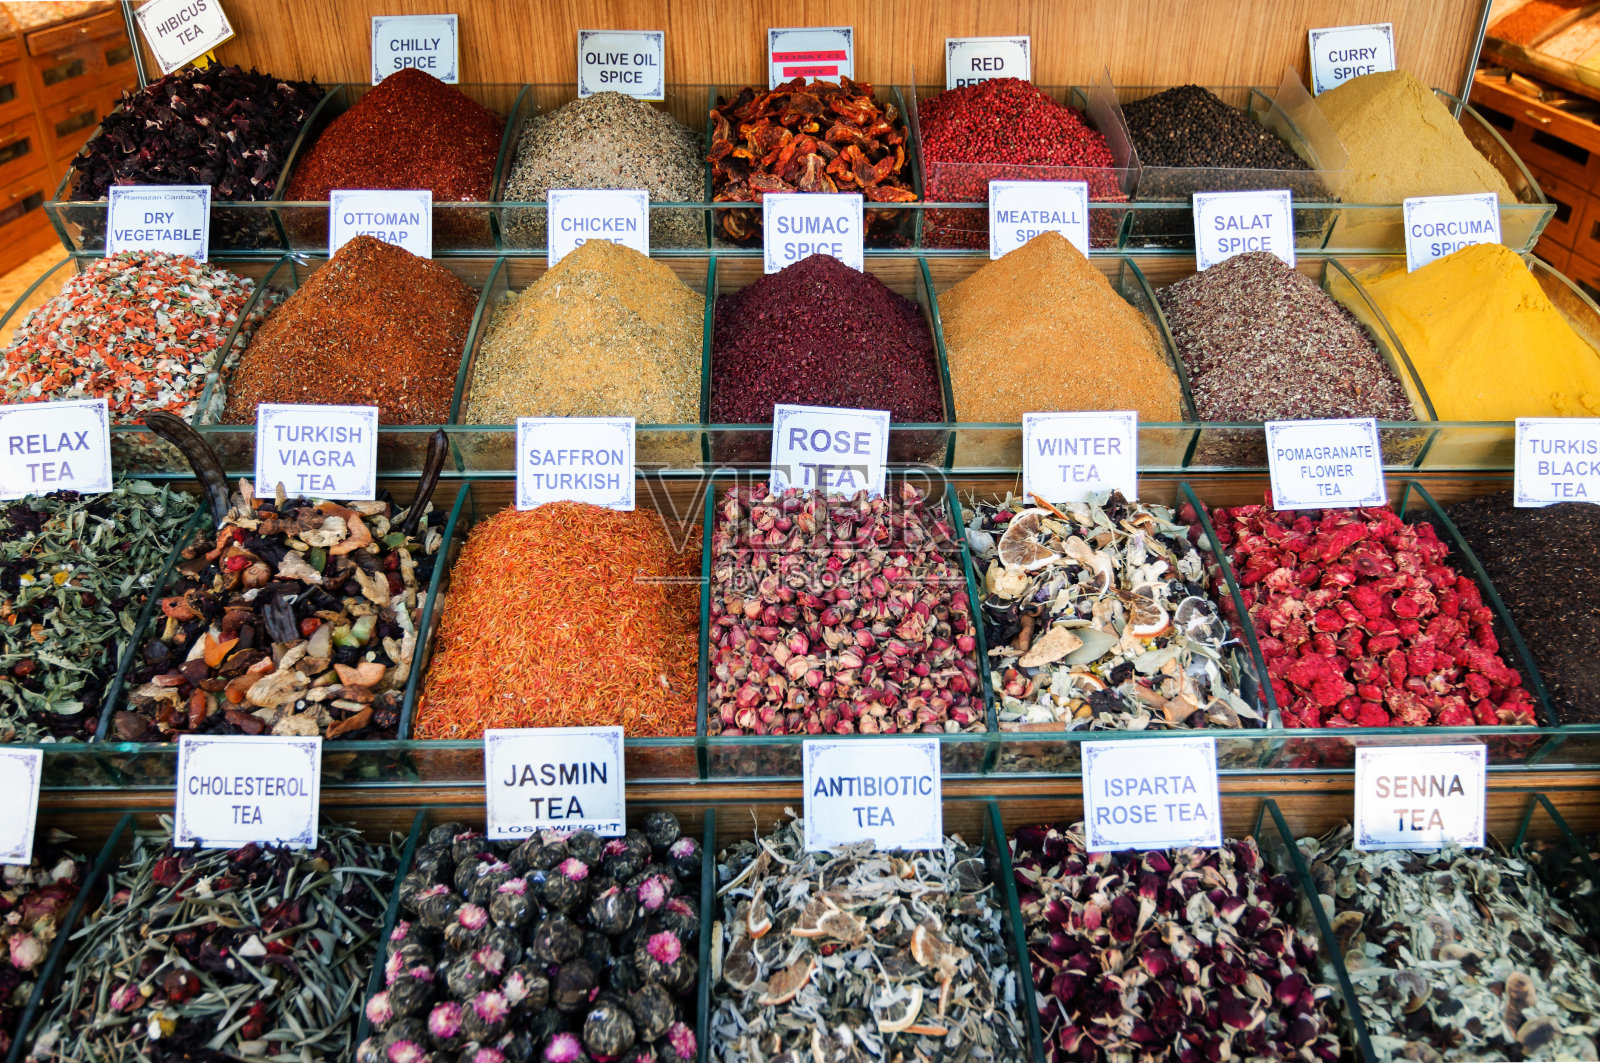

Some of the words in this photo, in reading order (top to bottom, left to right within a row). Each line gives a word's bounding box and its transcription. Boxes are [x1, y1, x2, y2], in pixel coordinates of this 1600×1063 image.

[156, 0, 207, 38] HIBICUS
[176, 24, 204, 46] TEA
[390, 38, 441, 52] CHILLY
[393, 56, 437, 69] SPICE
[585, 52, 629, 66] OLIVE
[634, 53, 658, 66] OIL
[971, 57, 1005, 71] RED
[1328, 47, 1377, 63] CURRY
[599, 70, 643, 84] SPICE
[144, 212, 174, 224] DRY
[343, 212, 420, 225] OTTOMAN
[561, 217, 637, 231] CHICKEN
[777, 216, 849, 234] SUMAC
[997, 210, 1080, 224] MEATBALL
[1214, 214, 1272, 231] SALAT
[114, 229, 202, 241] VEGETABLE
[1412, 219, 1494, 238] CORCUMA
[784, 242, 843, 260] SPICE
[1218, 236, 1271, 253] SPICE
[9, 431, 91, 455] RELAX
[274, 425, 362, 443] TURKISH
[789, 428, 871, 455] ROSE
[1037, 437, 1122, 457] WINTER
[1277, 445, 1373, 461] POMAGRANATE
[1529, 439, 1600, 455] TURKIS
[278, 449, 356, 468] VIAGRA
[529, 449, 624, 466] SAFFRON
[26, 461, 75, 483] TEA
[798, 462, 857, 488] TEA
[1058, 464, 1101, 483] TEA
[1300, 464, 1354, 479] FLOWER
[1538, 461, 1600, 476] BLACK
[297, 474, 336, 490] TEA
[533, 473, 620, 490] TURKISH
[1316, 483, 1342, 497] TEA
[1551, 482, 1588, 497] TEA
[503, 761, 608, 787] JASMIN
[188, 776, 309, 798] CHOLESTEROL
[813, 775, 933, 798] ANTIBIOTIC
[1104, 774, 1197, 797] ISPARTA
[1376, 774, 1464, 799] SENNA
[231, 805, 263, 825] TEA
[529, 796, 585, 819] TEA
[1096, 804, 1157, 826] ROSE
[1163, 802, 1208, 823] TEA
[852, 807, 896, 828] TEA
[1393, 808, 1444, 832] TEA
